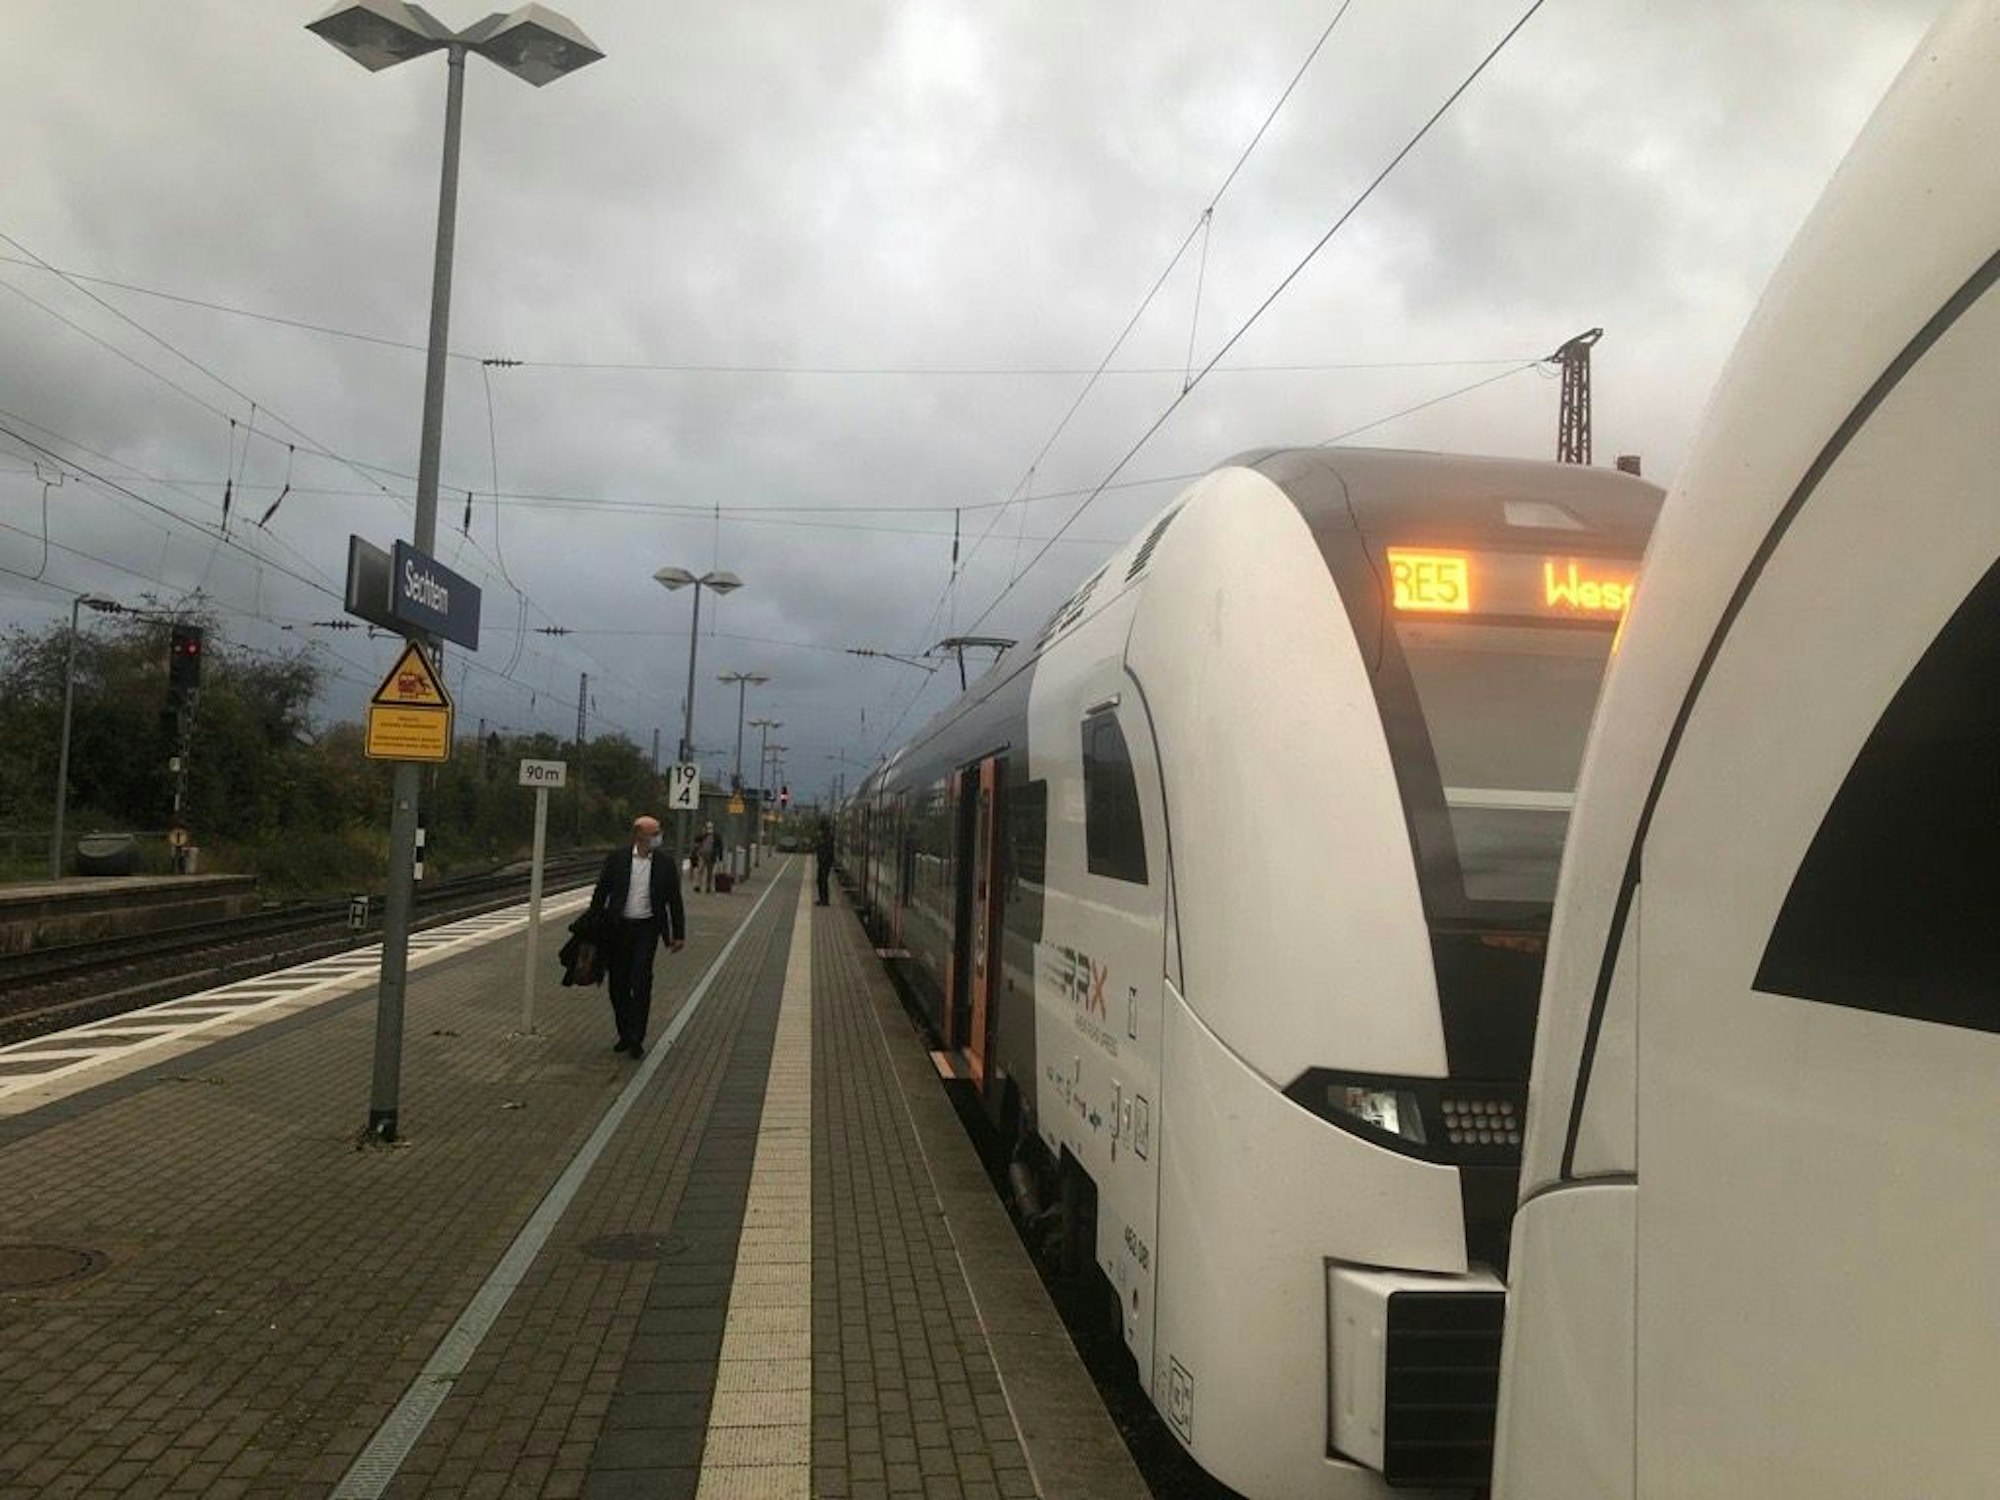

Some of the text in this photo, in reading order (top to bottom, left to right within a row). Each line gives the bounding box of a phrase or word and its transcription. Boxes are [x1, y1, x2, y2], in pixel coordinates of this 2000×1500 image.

[403, 559, 449, 616] Sechtem
[1394, 560, 1460, 603] RE5
[676, 766, 696, 784] 19
[678, 787, 690, 805] 4
[351, 905, 366, 926] H
